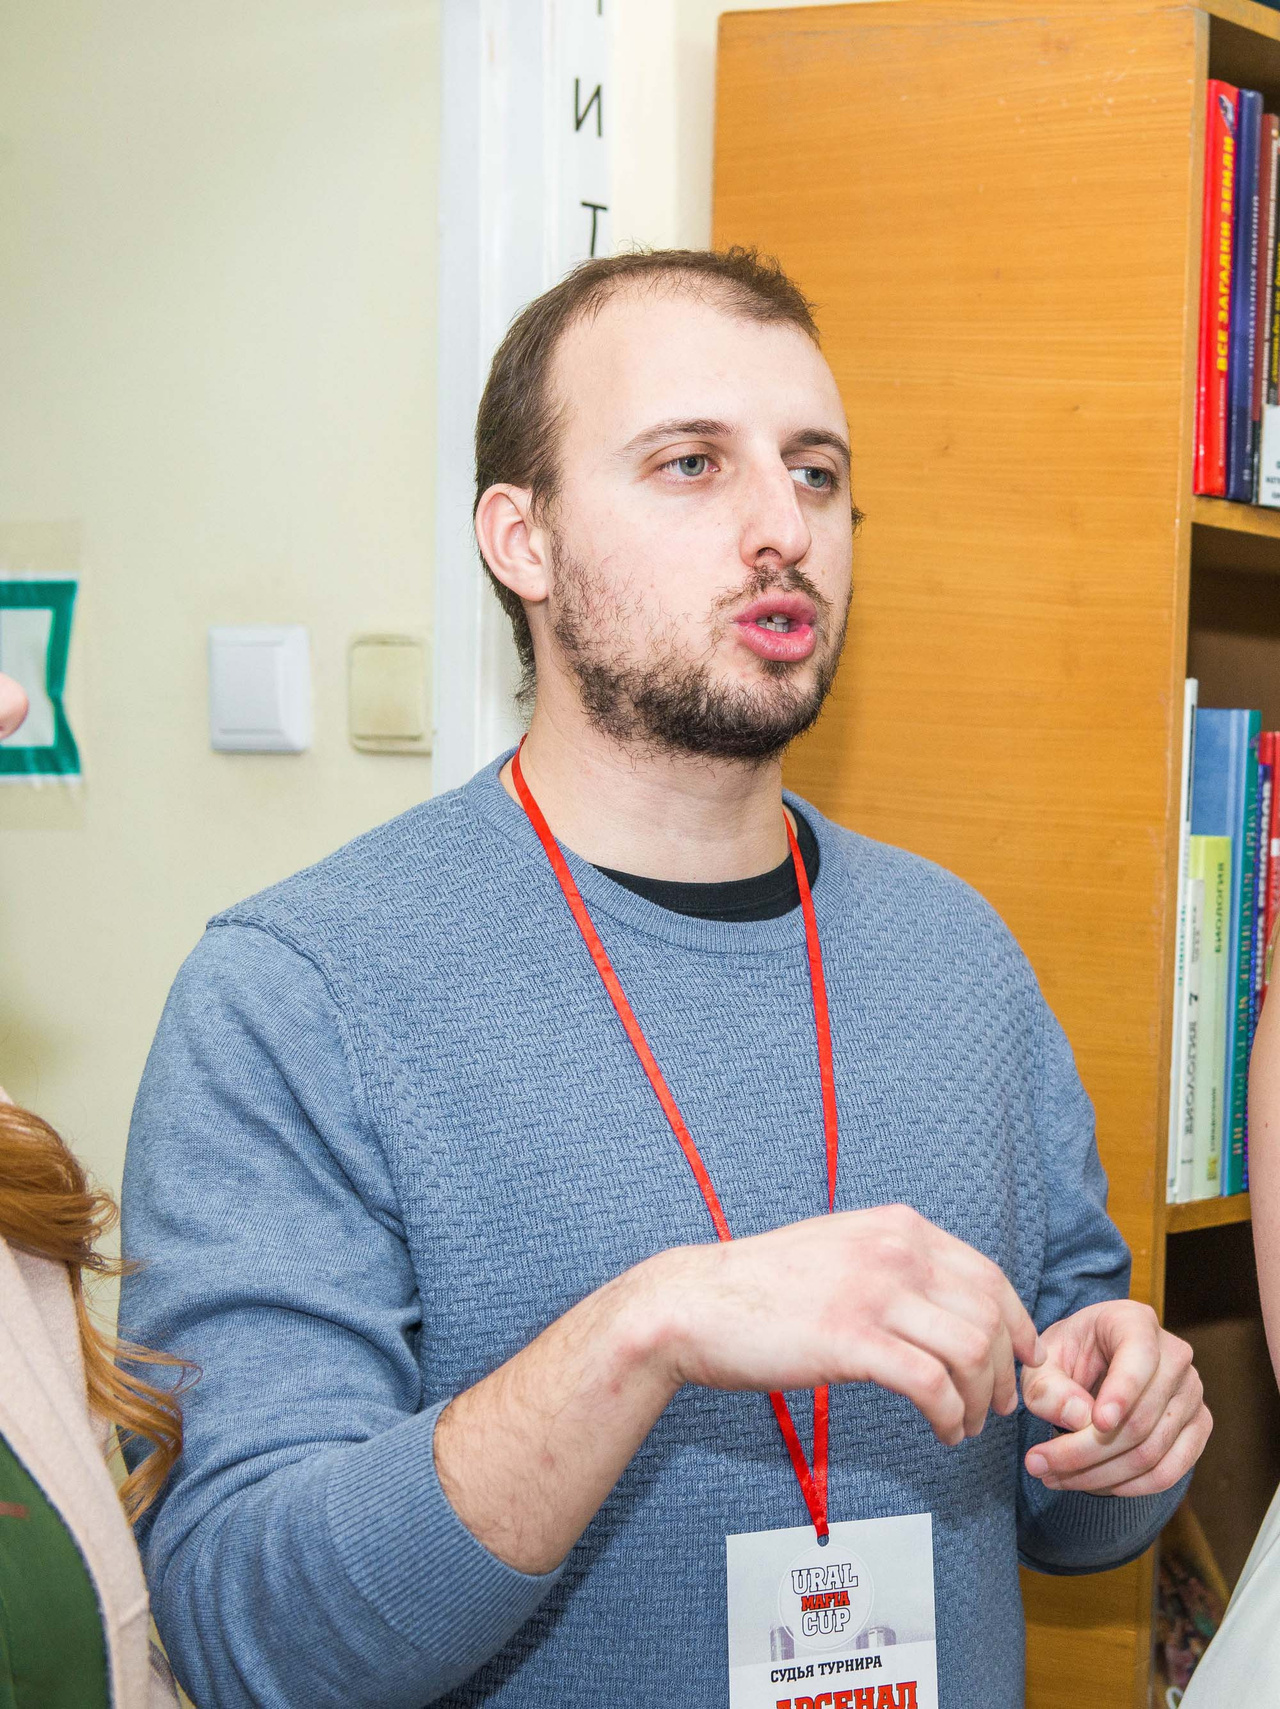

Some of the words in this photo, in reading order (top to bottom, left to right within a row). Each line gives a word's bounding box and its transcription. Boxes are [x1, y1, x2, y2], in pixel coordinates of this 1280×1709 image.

[1221, 135, 1235, 216] ЗЕМЛИ
[1218, 220, 1232, 324] ЗАГАДКИ
[1217, 328, 1230, 372] ВСЕ
[1214, 862, 1225, 953] БИОЛОГИЯ
[1184, 1020, 1198, 1135] БИОЛОГИЯ
[791, 1562, 859, 1595] URAL
[801, 1591, 850, 1612] MAFIA
[801, 1607, 851, 1637] CUP
[770, 1664, 815, 1683] СУДЬЯ
[817, 1655, 883, 1676] ТУРНИРА
